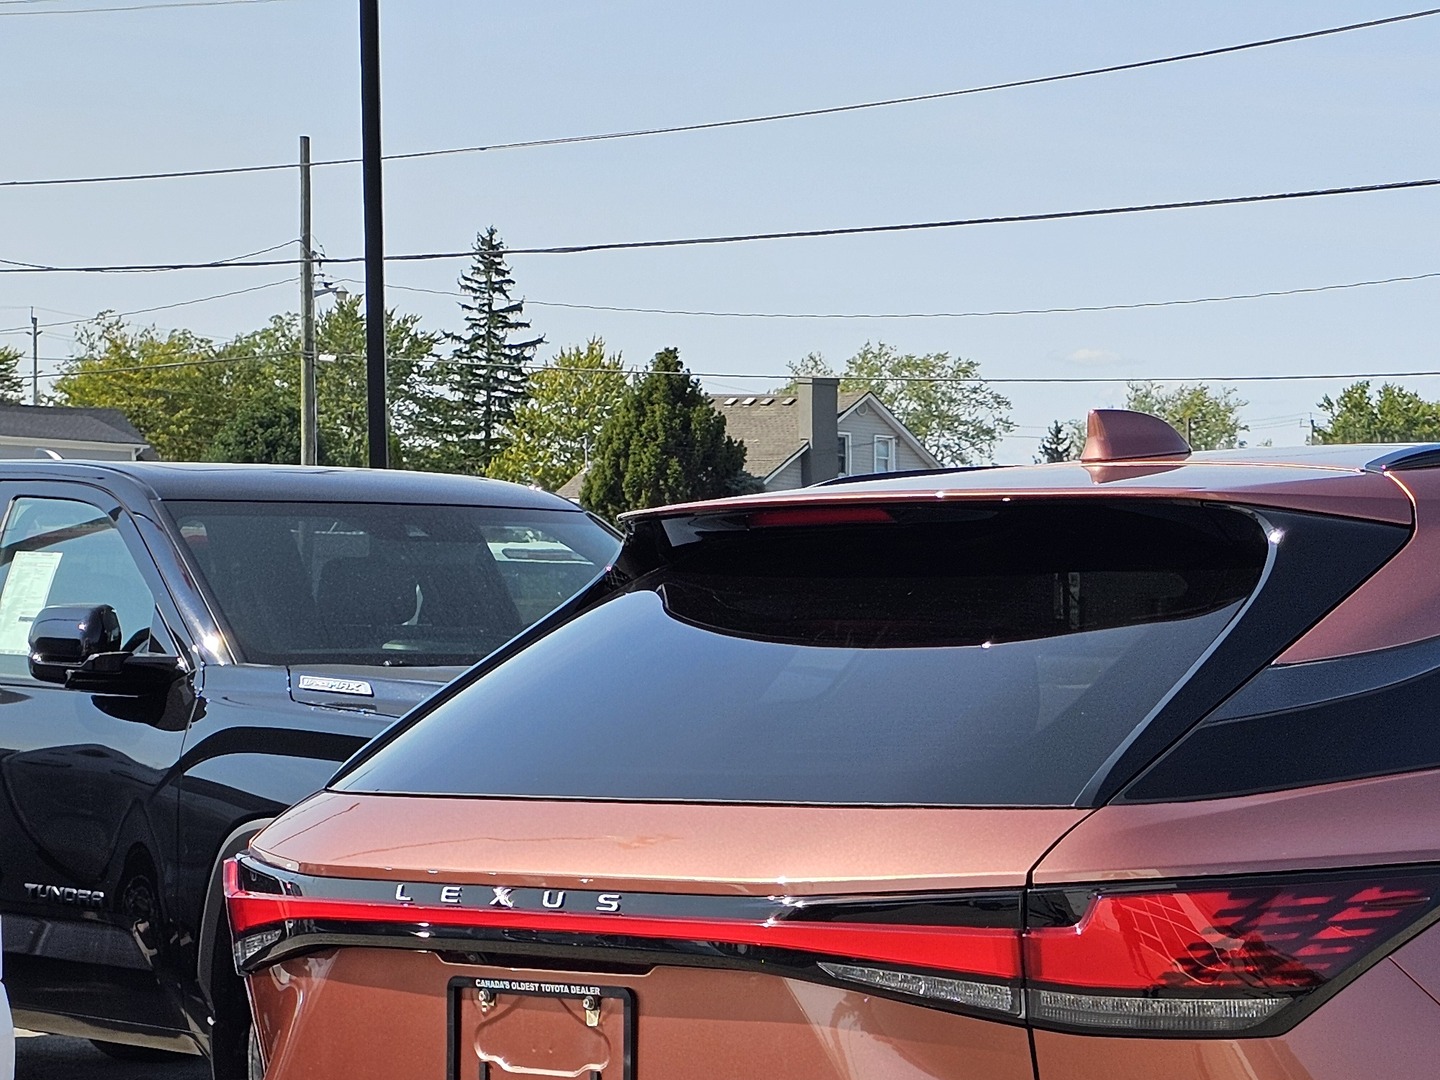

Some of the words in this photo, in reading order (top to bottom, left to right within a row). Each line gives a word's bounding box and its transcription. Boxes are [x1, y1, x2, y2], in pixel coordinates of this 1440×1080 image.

[24, 882, 105, 906] TUNDRA
[395, 883, 623, 913] LEXUS
[475, 978, 511, 990] CANADA'S
[511, 981, 540, 992] OLDEST
[540, 983, 570, 994] TOYOTA
[570, 986, 601, 996] DEALER
